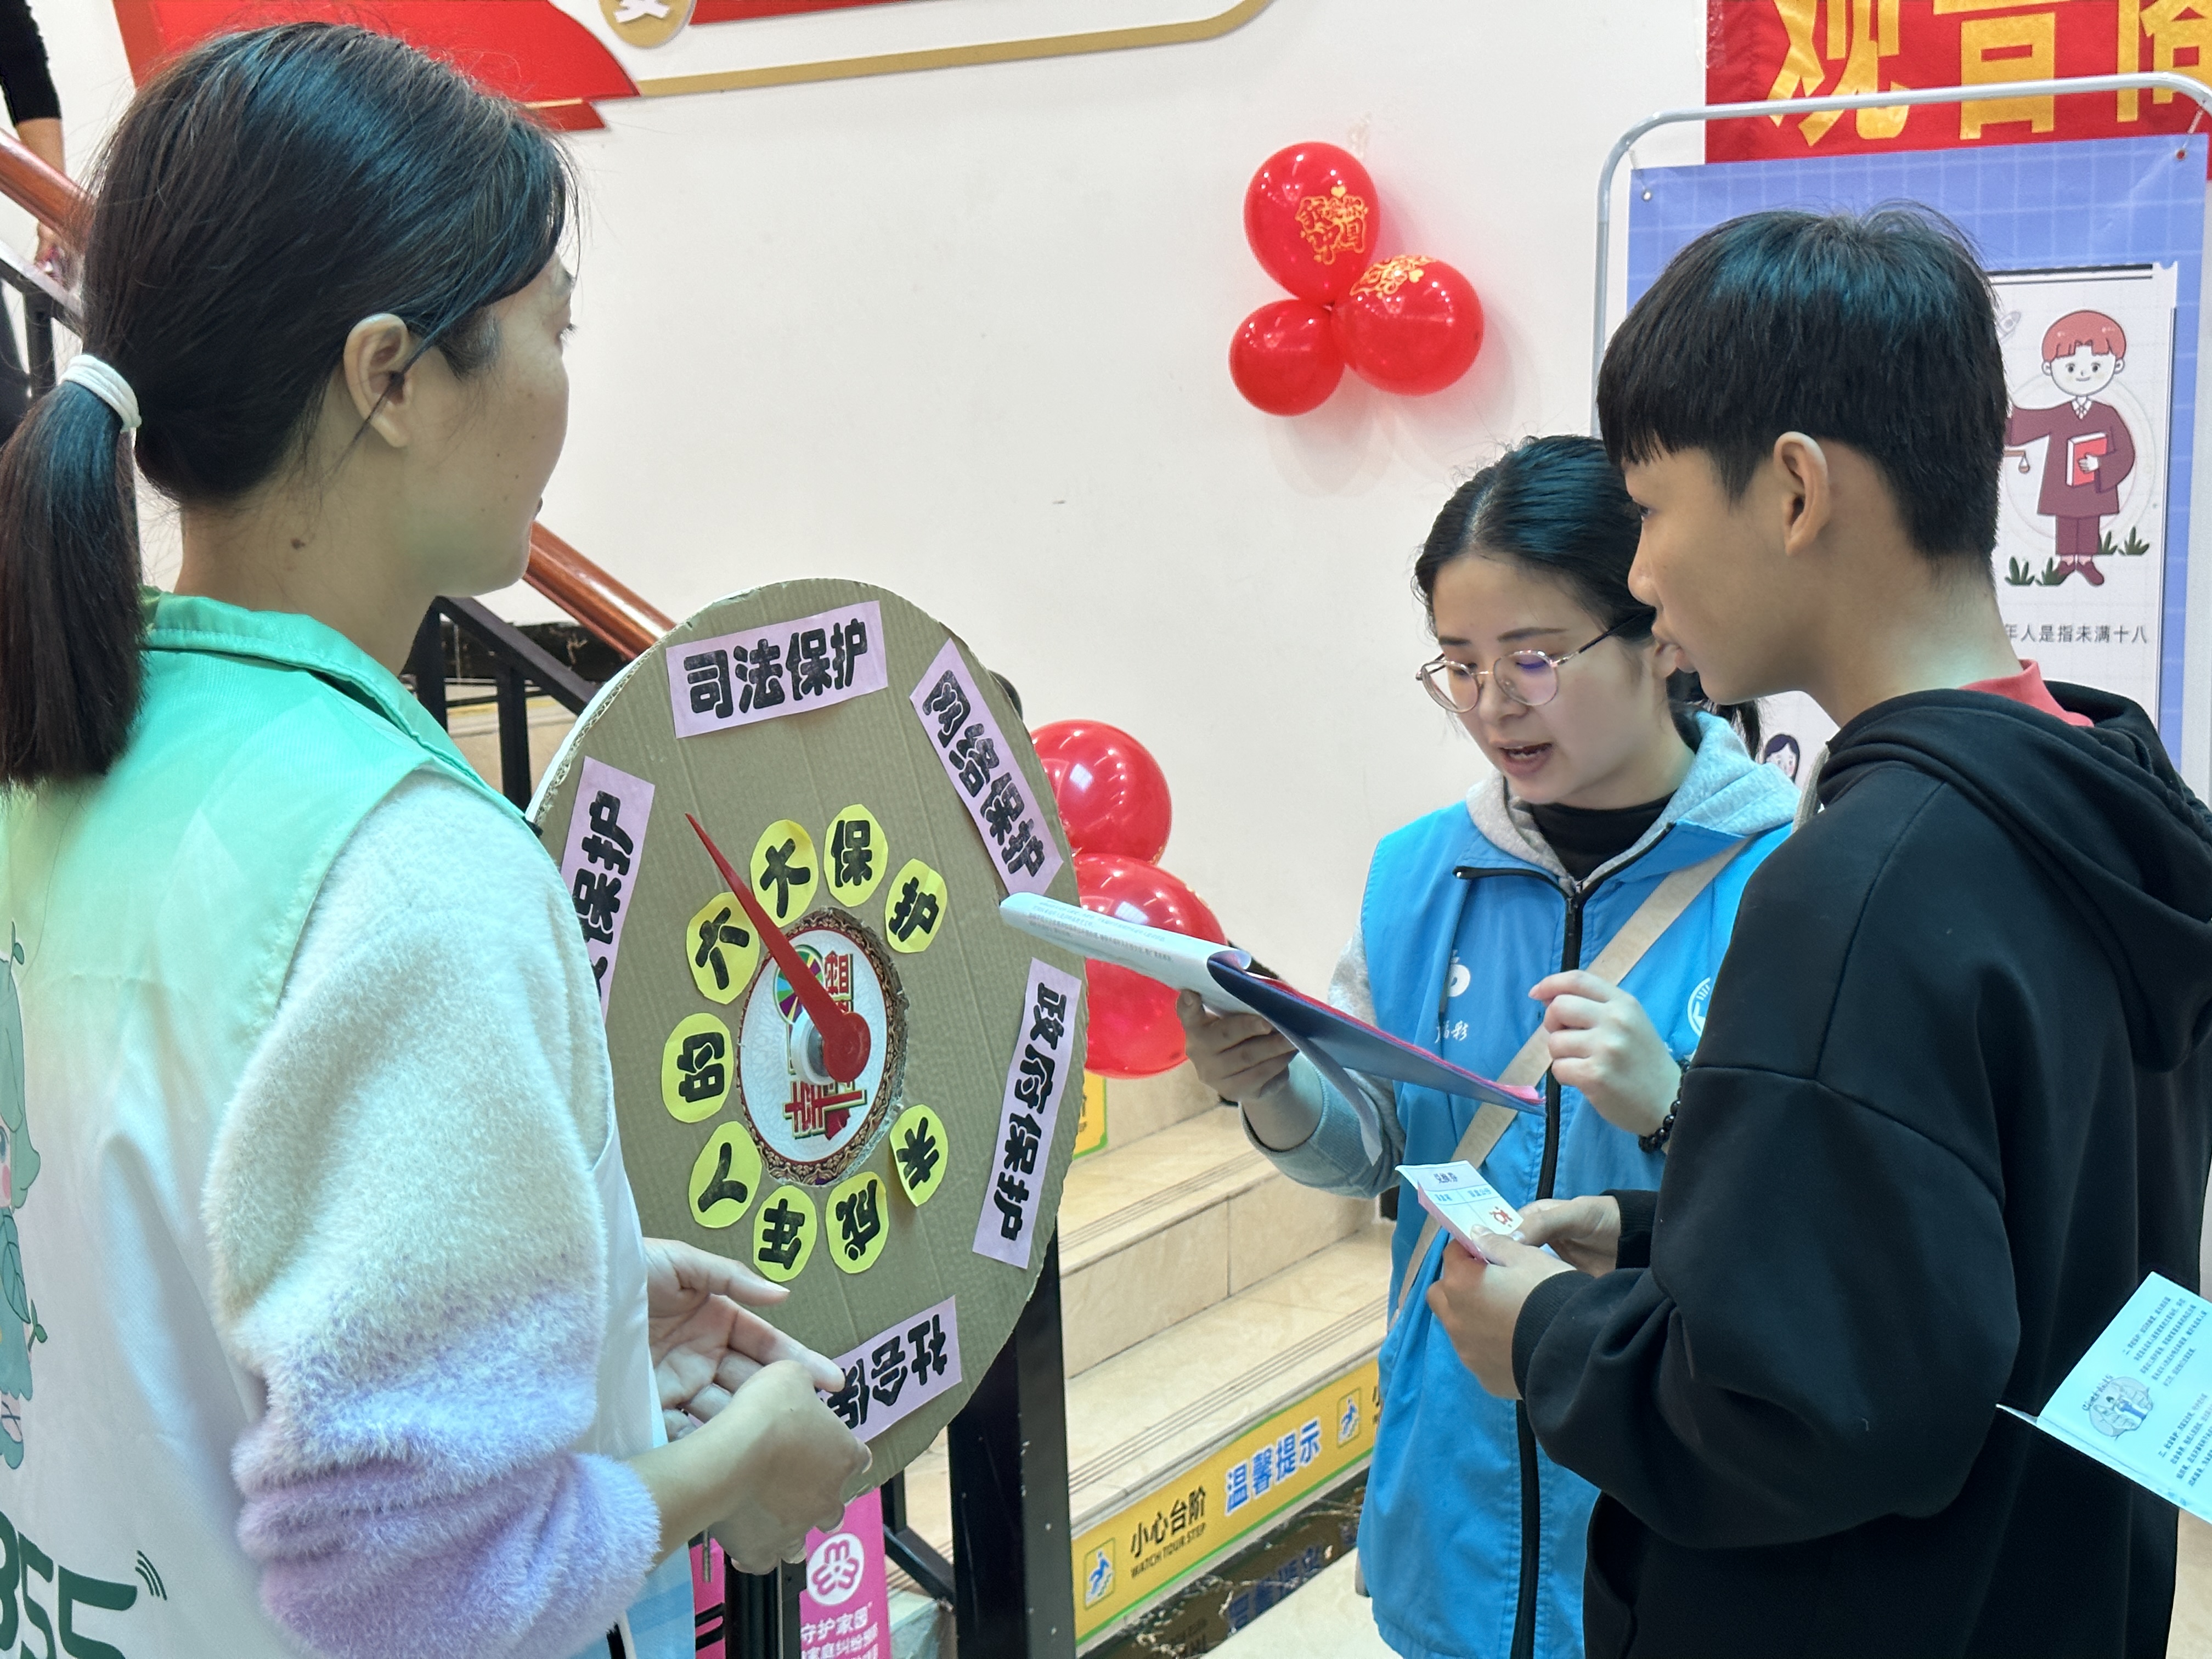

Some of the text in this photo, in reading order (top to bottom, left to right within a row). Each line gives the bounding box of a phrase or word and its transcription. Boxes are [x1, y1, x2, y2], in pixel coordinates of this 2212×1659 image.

[684, 619, 868, 718] 司法保护
[923, 670, 1046, 877] 网络保护
[572, 790, 634, 1003] 保护
[994, 982, 1067, 1240] 政府保护
[820, 1314, 947, 1430] 社会保
[1131, 1486, 1206, 1558] 小心台阶
[1224, 1418, 1321, 1514] 温馨提示
